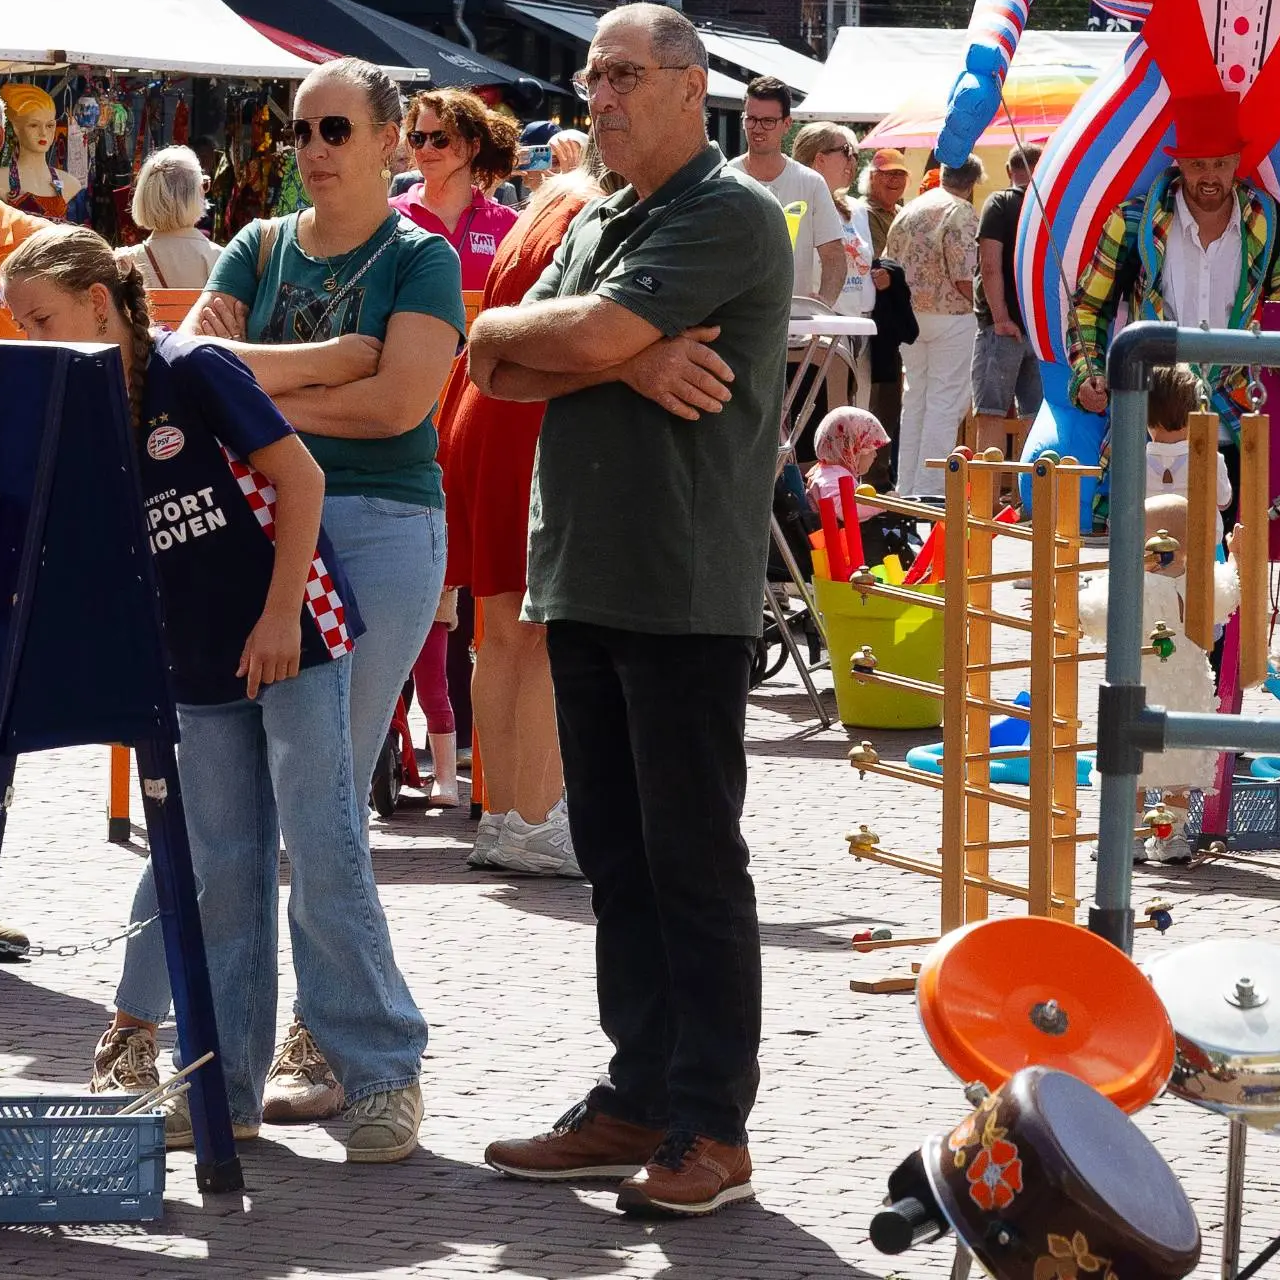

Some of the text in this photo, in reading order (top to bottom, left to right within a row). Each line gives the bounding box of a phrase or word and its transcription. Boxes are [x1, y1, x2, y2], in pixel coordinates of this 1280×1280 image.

[157, 436, 170, 447] PSV
[143, 488, 177, 508] LREGIO
[146, 486, 214, 532] PORT
